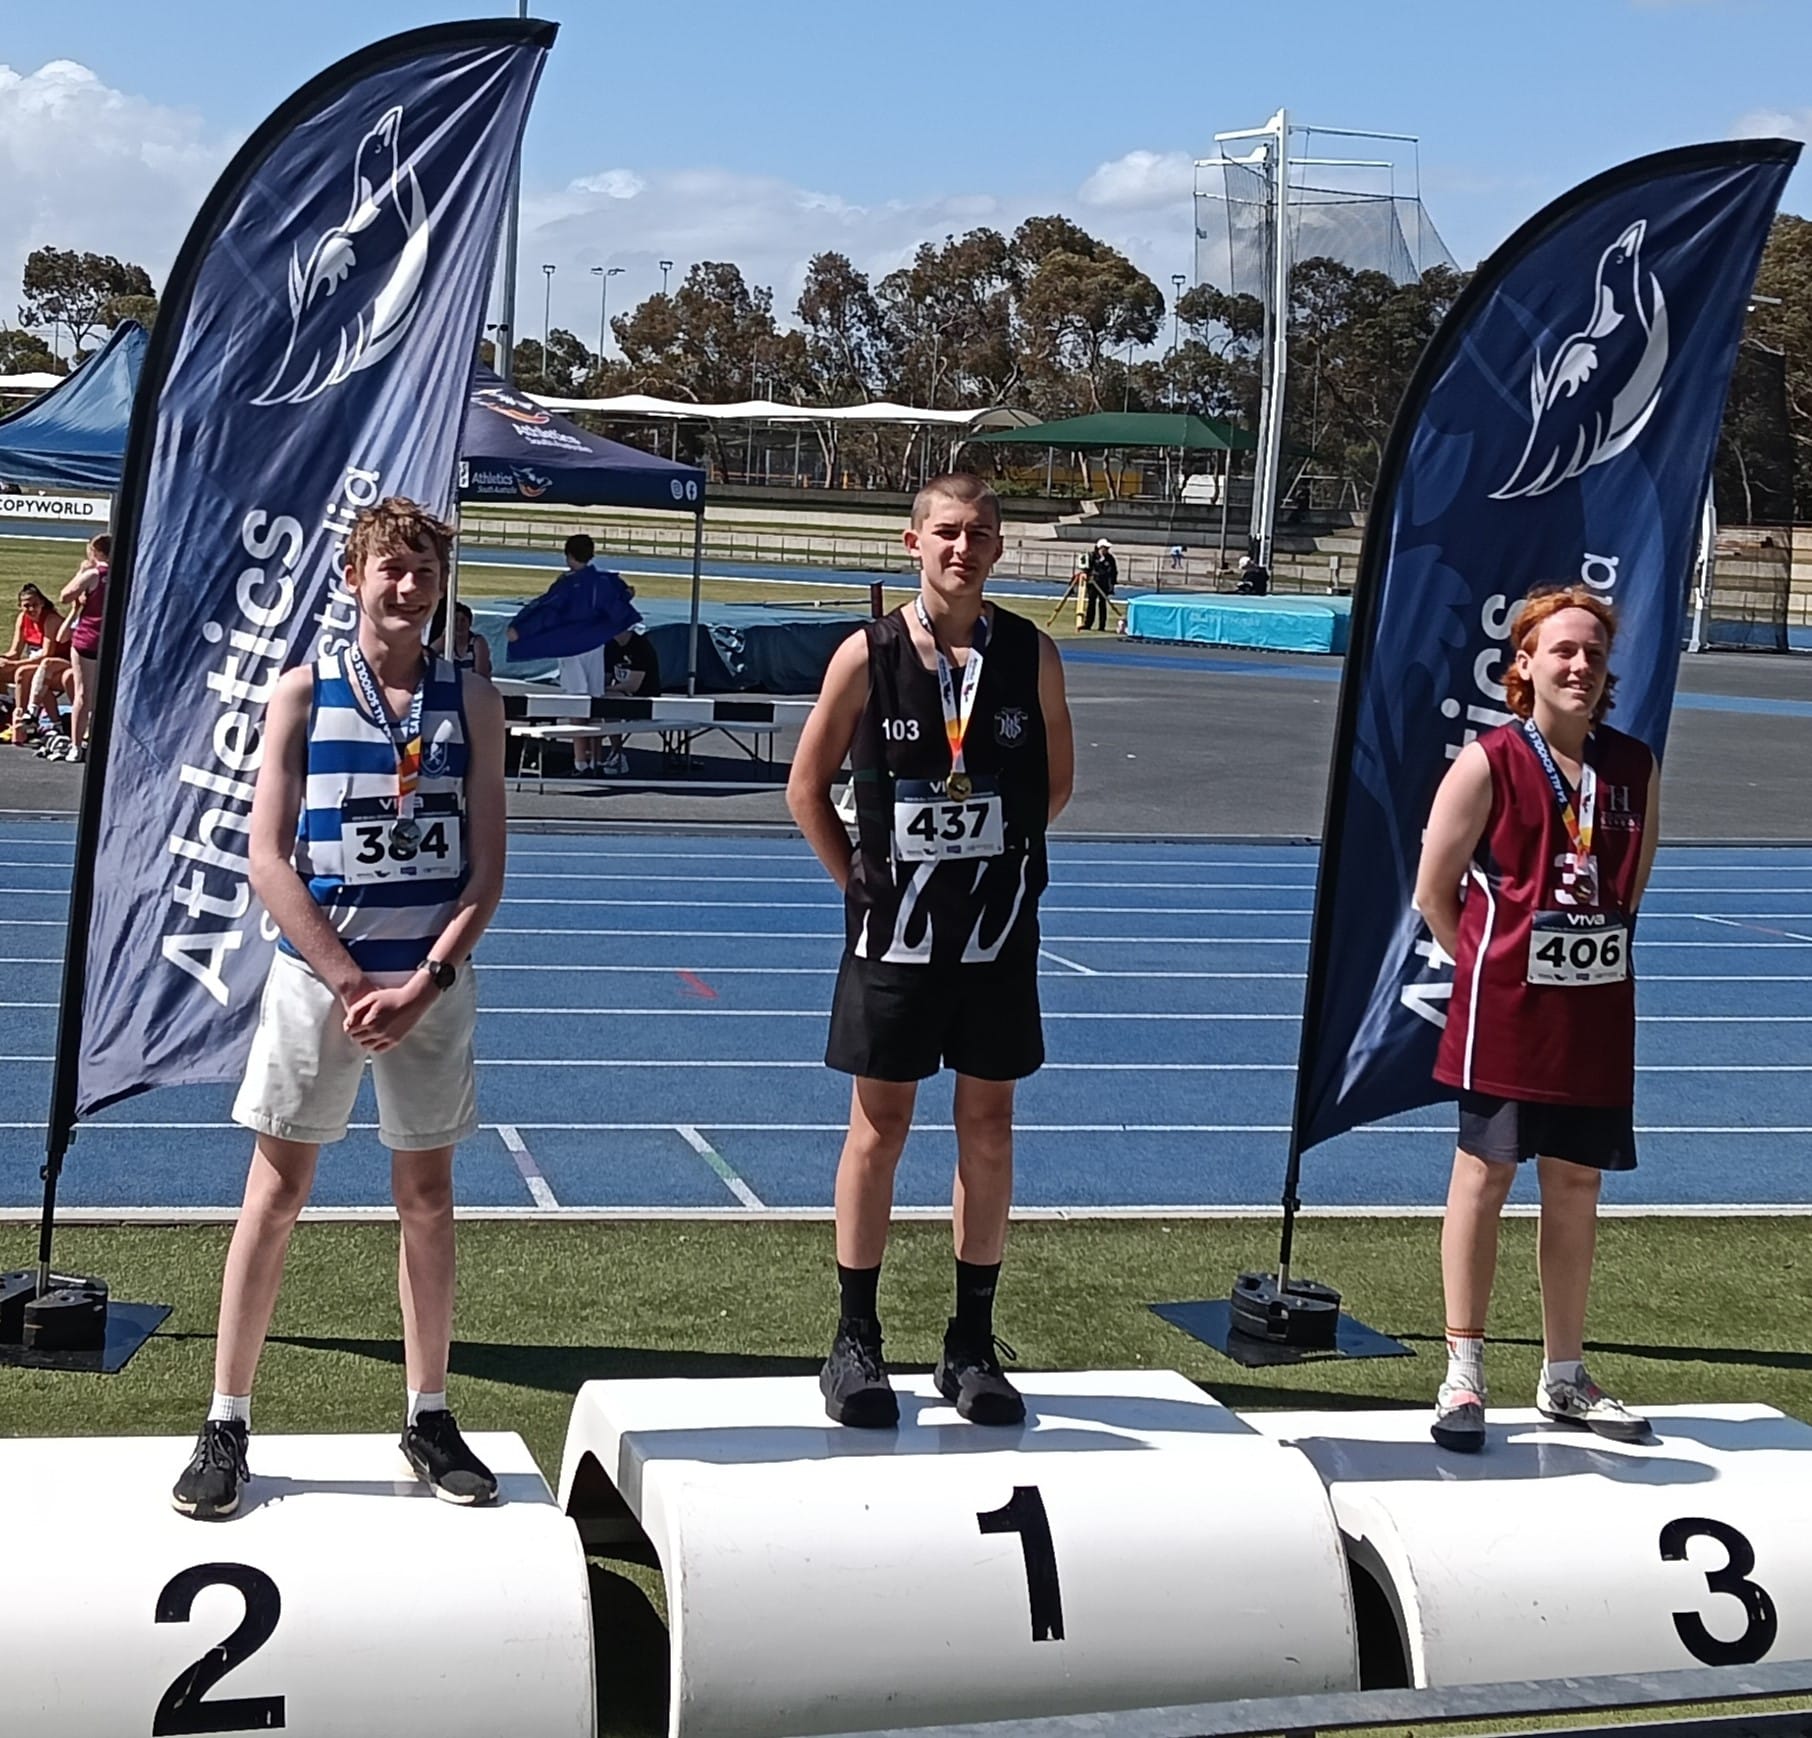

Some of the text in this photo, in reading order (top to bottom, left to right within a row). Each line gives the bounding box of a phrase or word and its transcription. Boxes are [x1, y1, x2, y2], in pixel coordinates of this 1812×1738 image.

[471, 471, 513, 485] Athletics
[355, 661, 379, 707] SCHOOLS
[882, 718, 920, 741] 103
[162, 509, 303, 1006] Athletics
[1529, 731, 1556, 773] SCHOOLS
[1550, 772, 1564, 794] ALL
[907, 802, 989, 841] 437
[1536, 934, 1620, 969] 406
[977, 1485, 1065, 1641] 1
[1659, 1517, 1778, 1667] 3
[152, 1562, 286, 1737] 2
